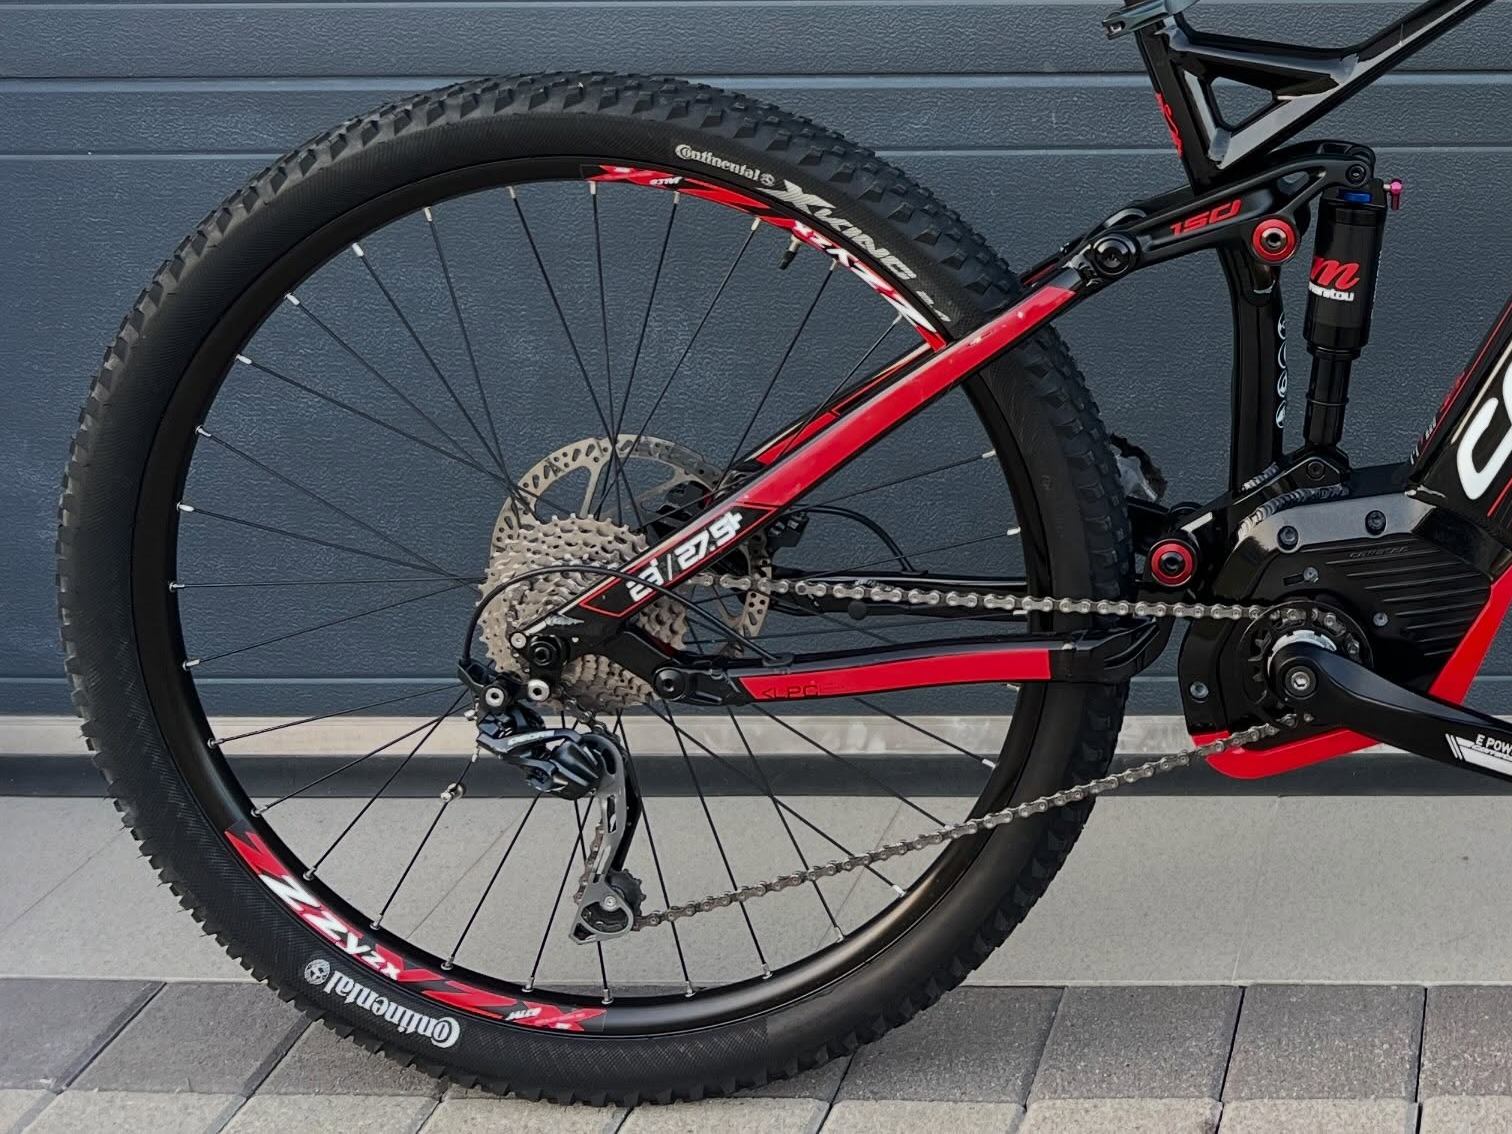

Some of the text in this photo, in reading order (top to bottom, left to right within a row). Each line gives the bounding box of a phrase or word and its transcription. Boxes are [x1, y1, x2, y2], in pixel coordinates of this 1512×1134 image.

[674, 143, 761, 182] Continental
[1169, 198, 1243, 238] 150
[322, 969, 462, 1049] Continental
